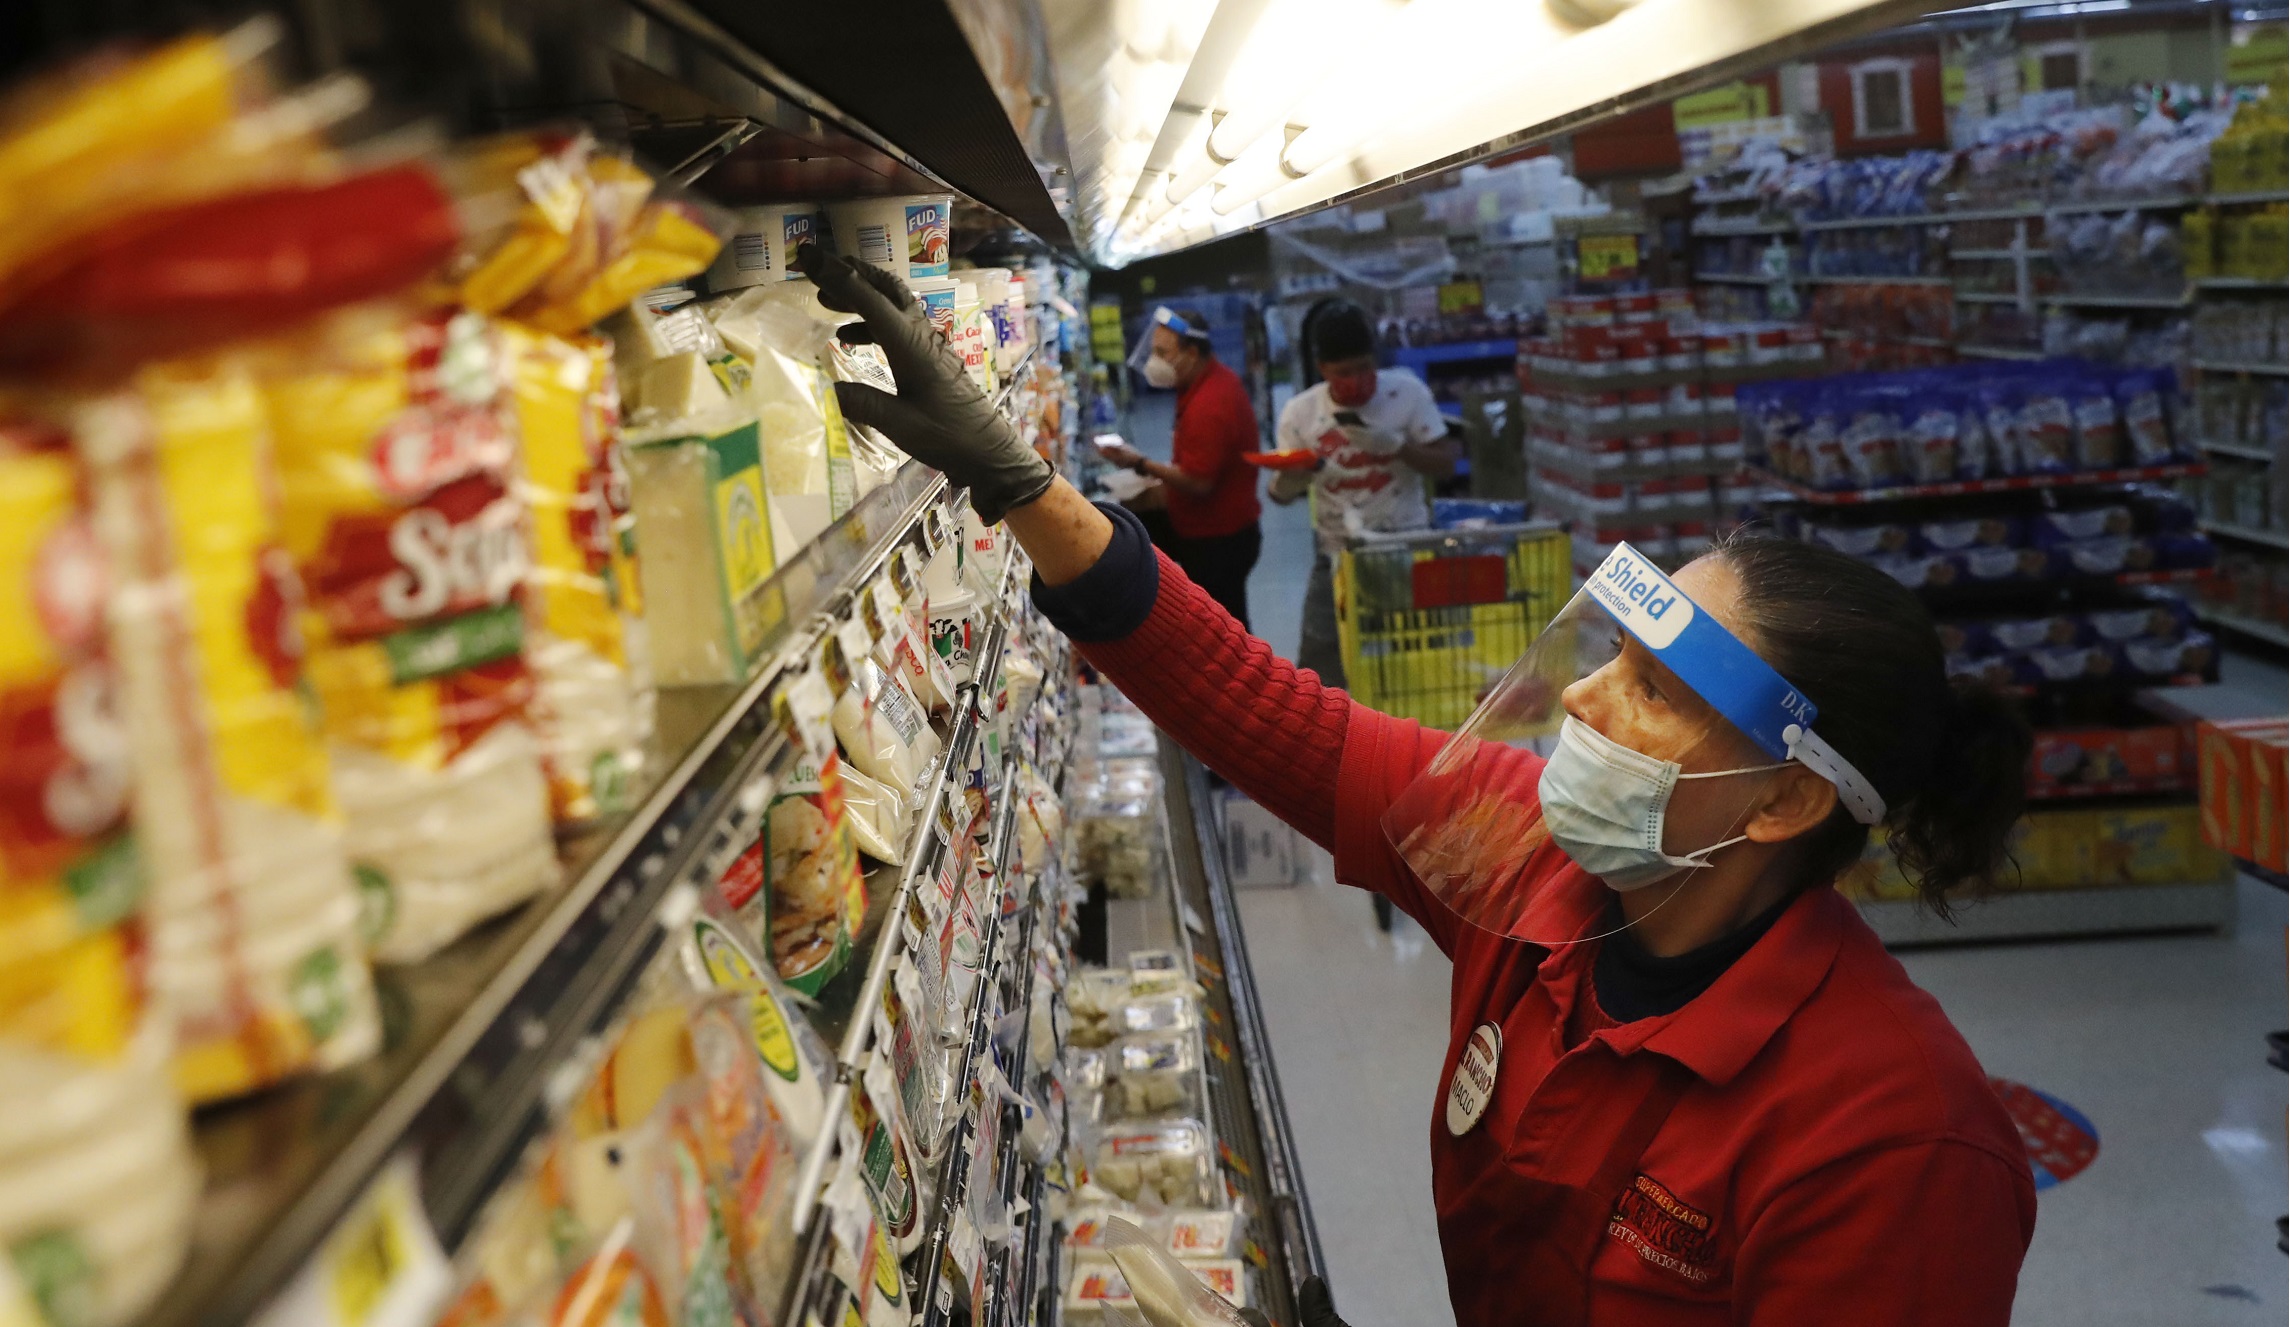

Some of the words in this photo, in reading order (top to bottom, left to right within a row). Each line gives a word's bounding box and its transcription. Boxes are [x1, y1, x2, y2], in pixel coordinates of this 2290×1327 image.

[786, 219, 809, 240] FUD
[908, 209, 936, 231] FUD
[1592, 580, 1632, 617] protection
[1606, 557, 1676, 621] Shield
[1781, 690, 1812, 725] D.K.
[1635, 1176, 1709, 1231] SUPERMERCADO
